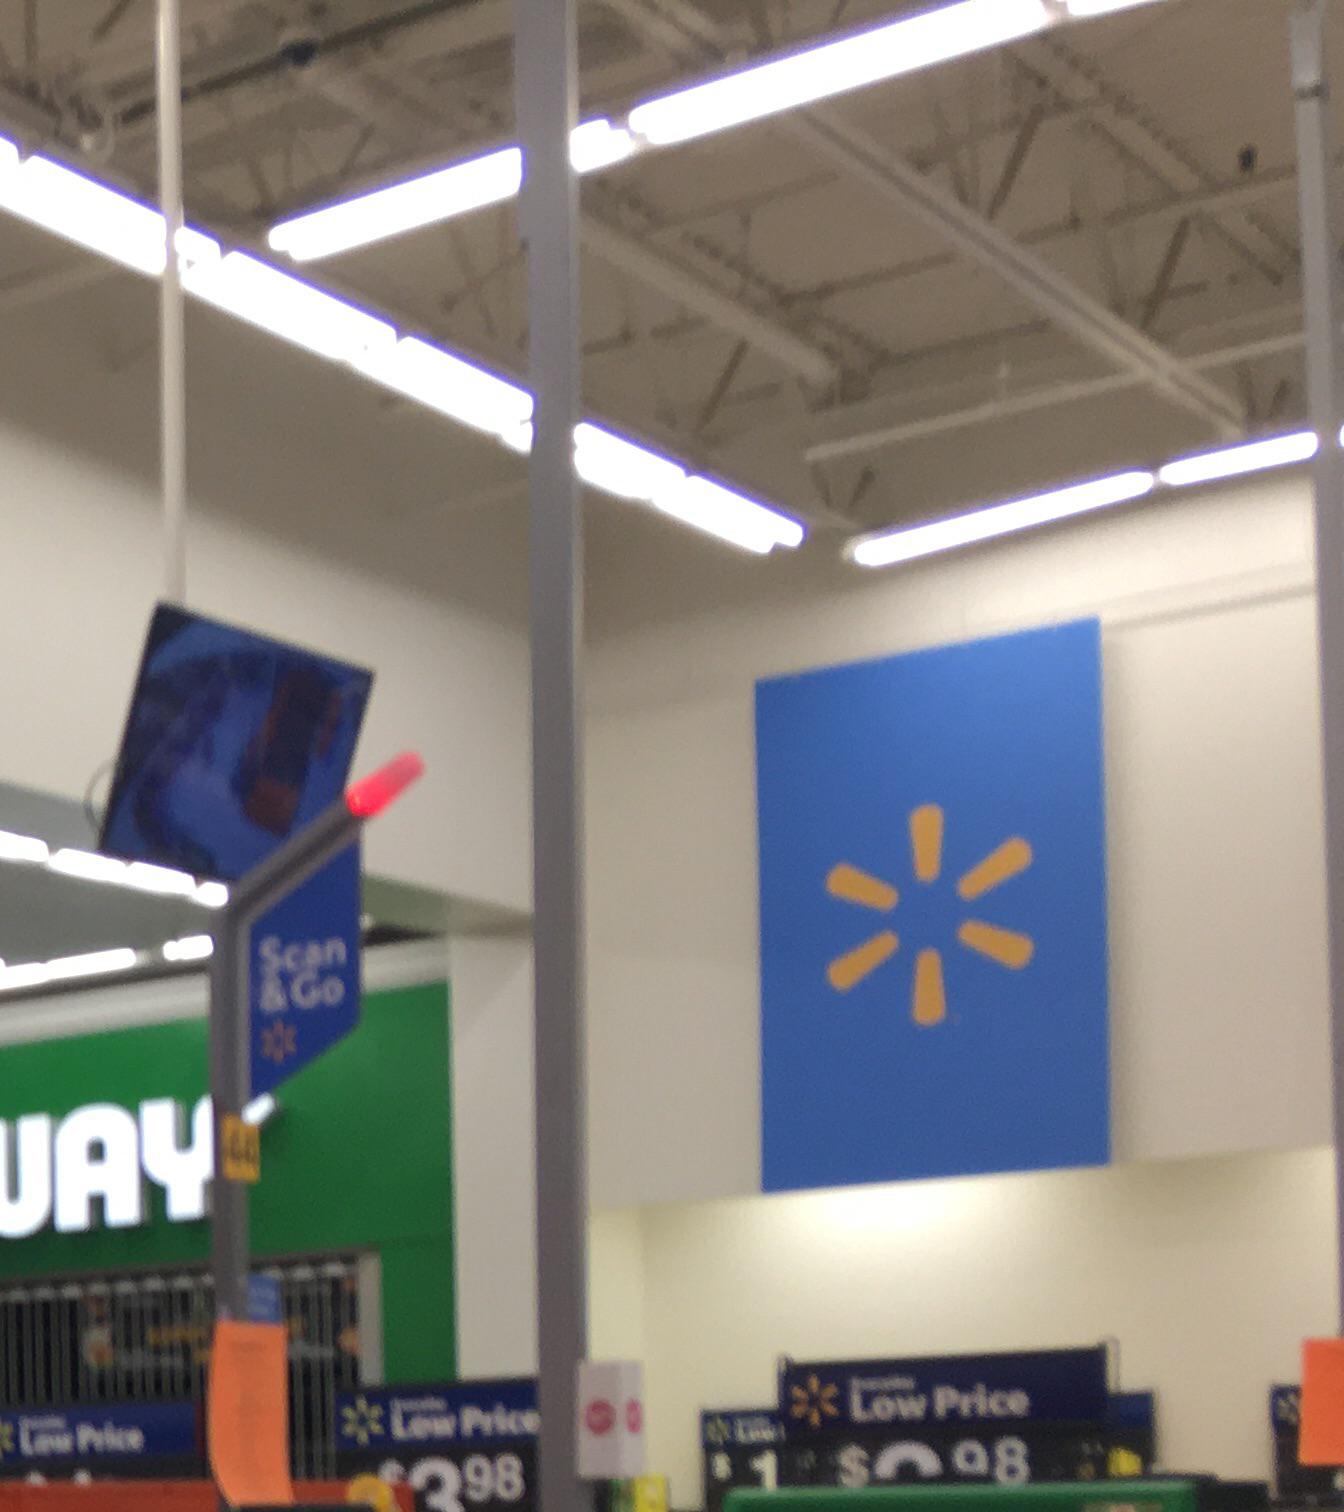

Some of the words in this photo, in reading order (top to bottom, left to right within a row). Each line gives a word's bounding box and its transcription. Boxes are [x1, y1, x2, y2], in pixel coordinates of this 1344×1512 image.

[258, 934, 347, 978] Scan
[389, 1399, 455, 1441] Low
[849, 1377, 928, 1423] Low
[931, 1384, 1030, 1419] Price
[18, 1416, 73, 1456] Low
[75, 1421, 144, 1454] Price
